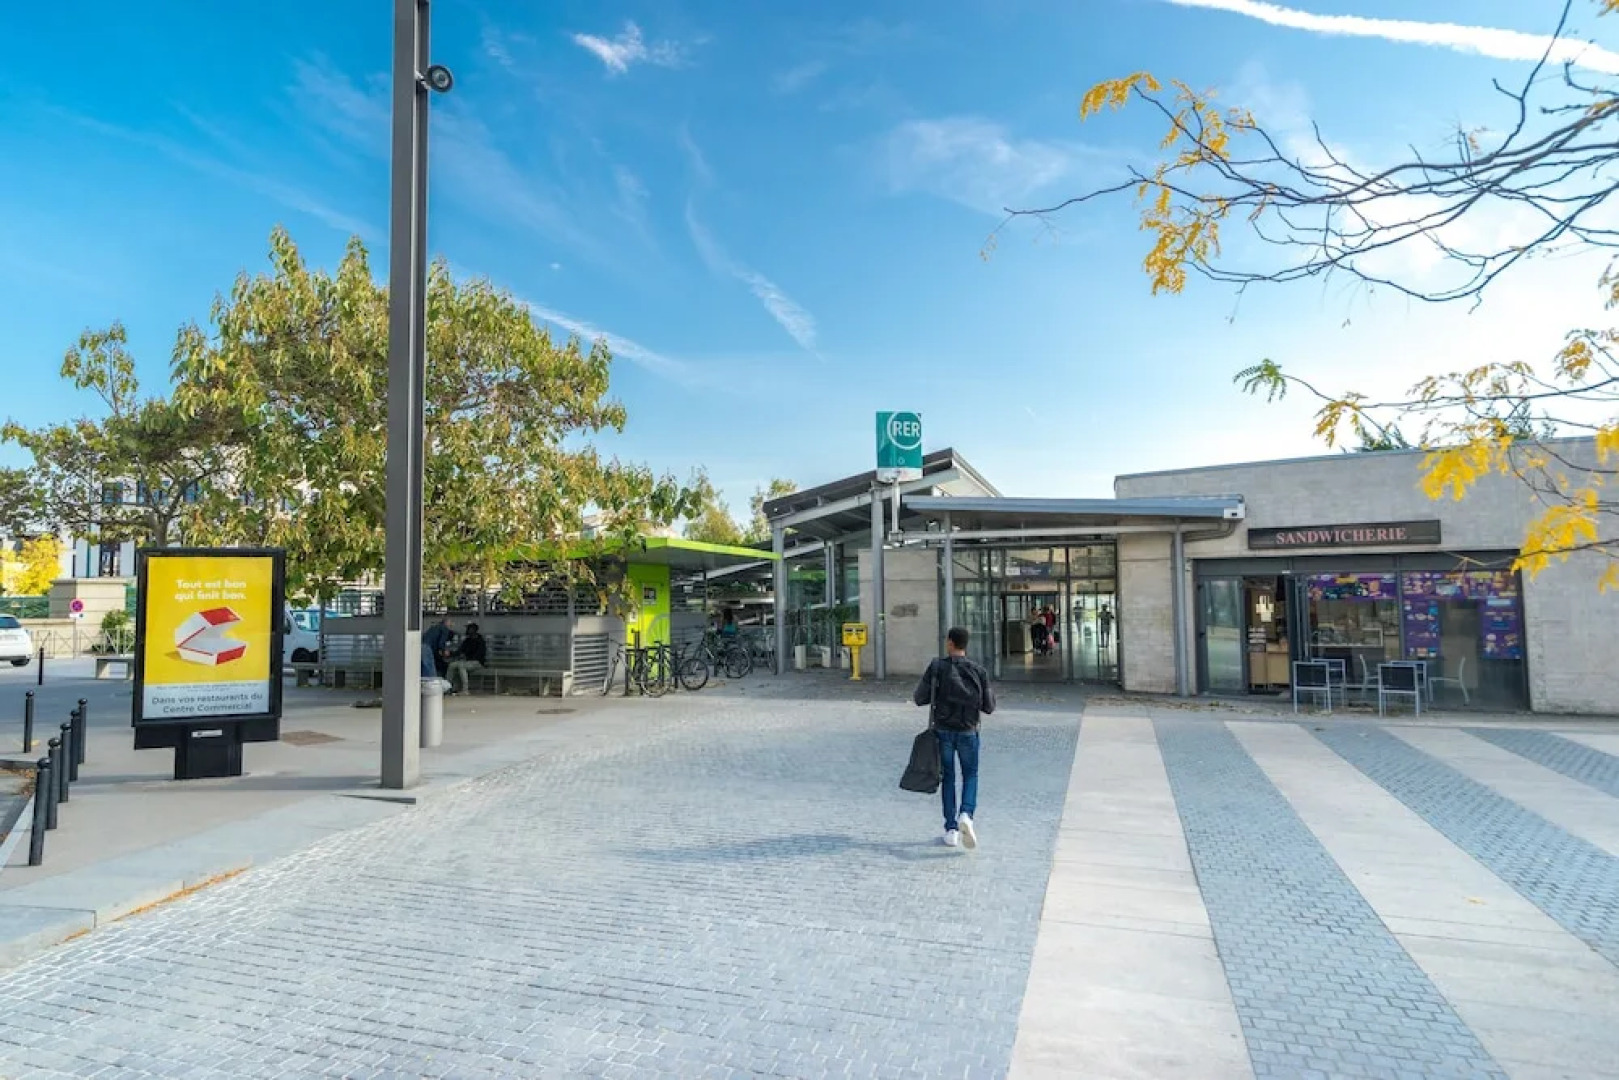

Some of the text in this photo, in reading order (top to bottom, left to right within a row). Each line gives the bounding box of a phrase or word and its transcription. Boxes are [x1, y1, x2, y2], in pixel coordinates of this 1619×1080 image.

[892, 420, 921, 437] RER
[1275, 527, 1407, 544] SANDWICHERIE
[176, 579, 247, 589] Tout est bon
[174, 591, 194, 602] qui
[197, 590, 219, 600] finit
[151, 692, 263, 705] Dans vos restaurants du
[162, 702, 252, 714] Centre Commercial
